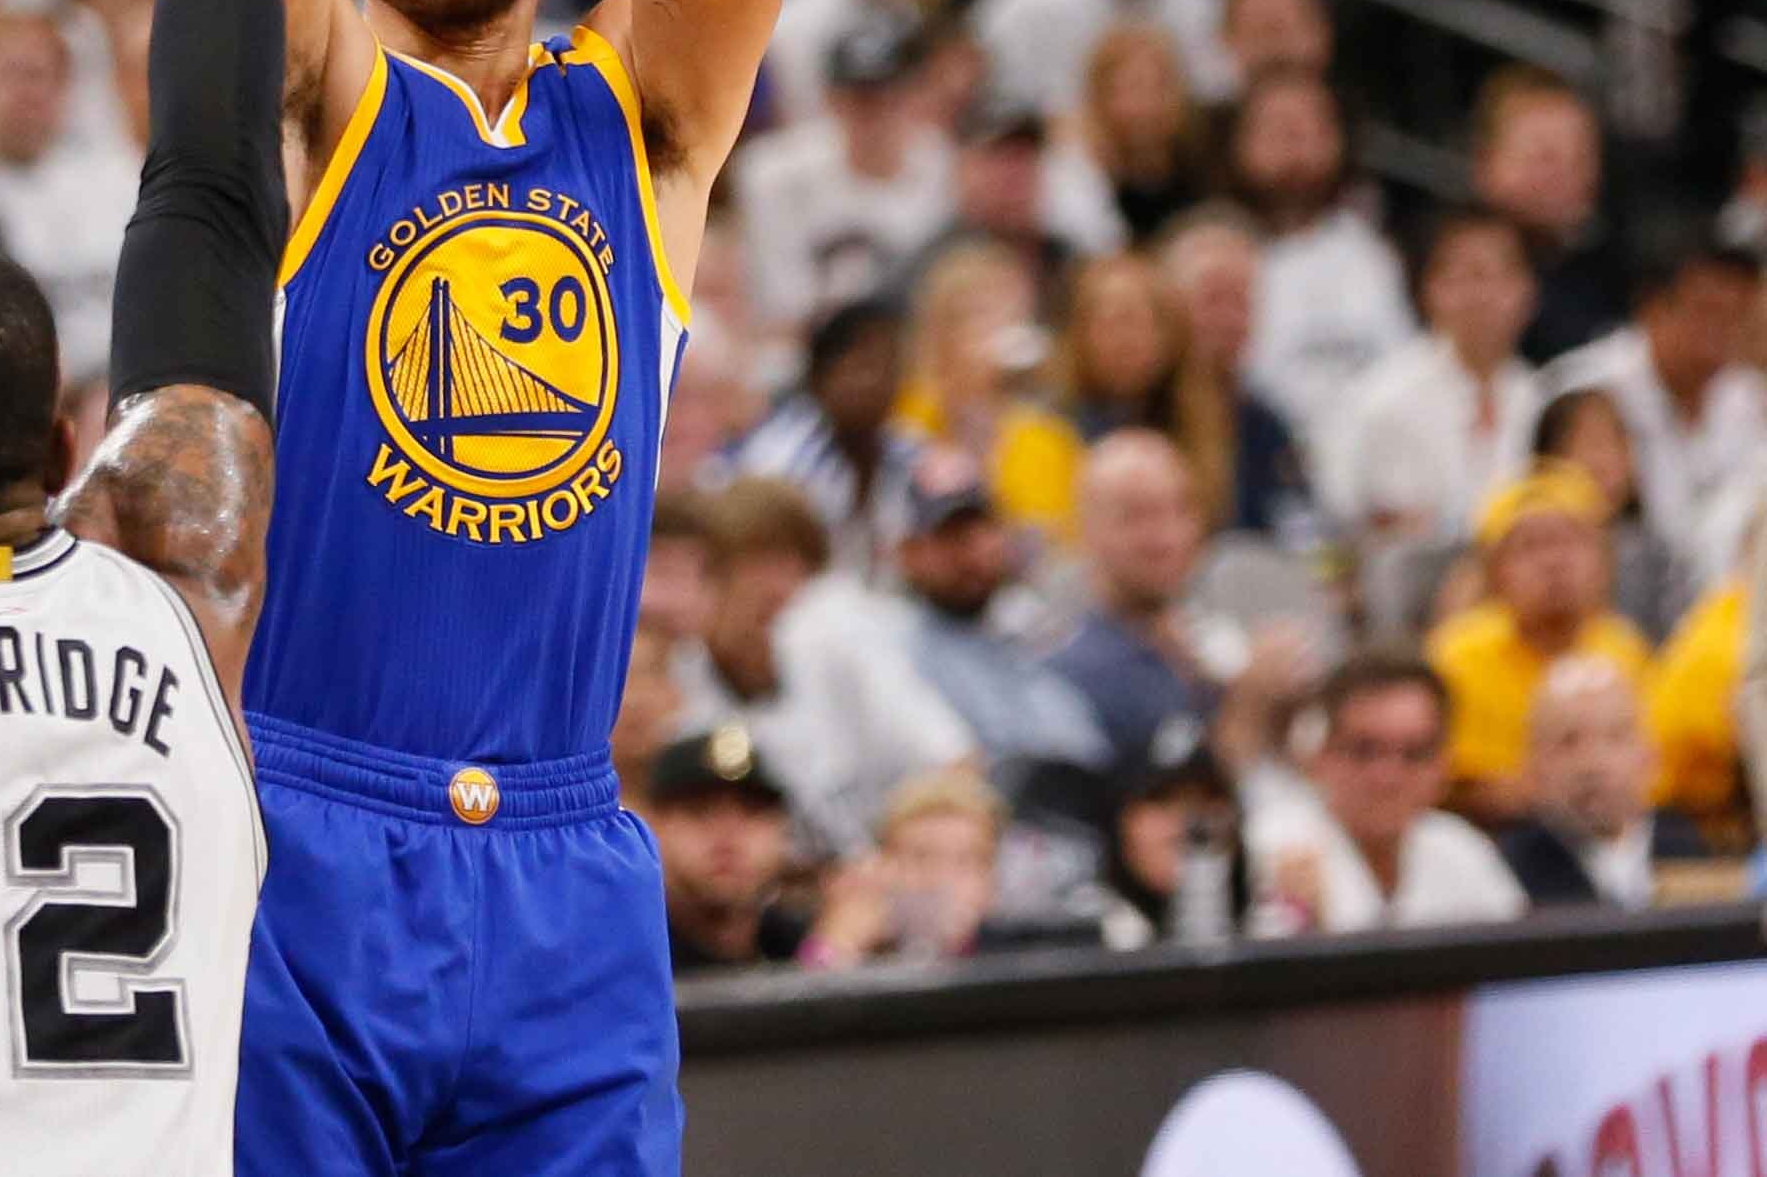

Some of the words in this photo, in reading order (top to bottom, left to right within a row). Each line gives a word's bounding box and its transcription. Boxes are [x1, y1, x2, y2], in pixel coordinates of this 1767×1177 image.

[368, 183, 510, 271] GOLDEN
[527, 188, 615, 274] STATE
[499, 275, 587, 345] 30
[367, 439, 622, 543] WARRIORS
